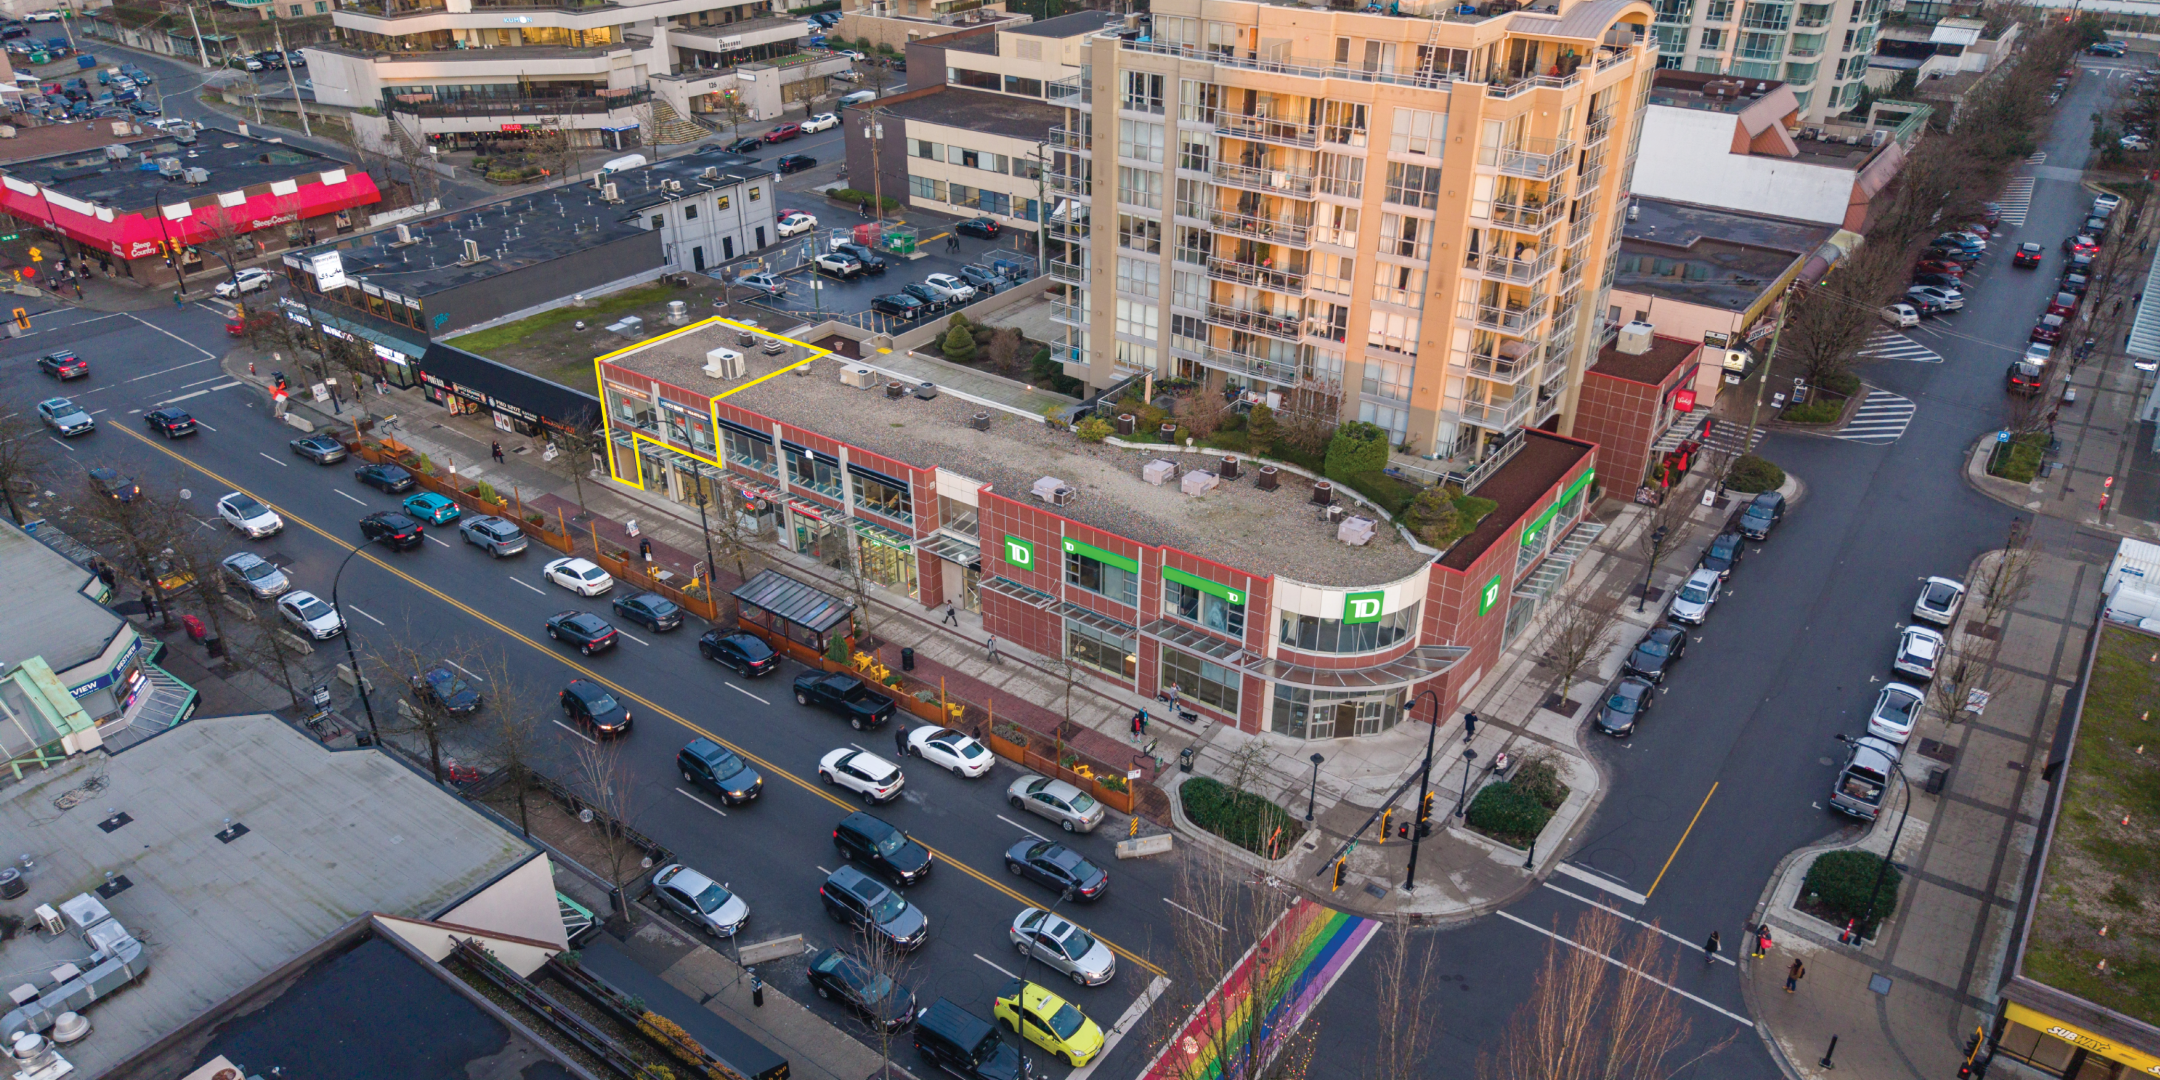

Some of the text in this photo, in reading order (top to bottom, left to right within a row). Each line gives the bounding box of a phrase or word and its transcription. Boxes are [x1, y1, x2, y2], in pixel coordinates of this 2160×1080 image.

[131, 247, 156, 258] Country
[133, 241, 151, 250] Sleep
[1007, 541, 1030, 564] TD
[1064, 541, 1075, 552] TD
[1228, 591, 1239, 603] TD
[1486, 584, 1499, 607] TD
[1351, 598, 1380, 618] TD
[116, 643, 137, 672] WESTVIEW
[2047, 1026, 2111, 1052] SUBWAY
